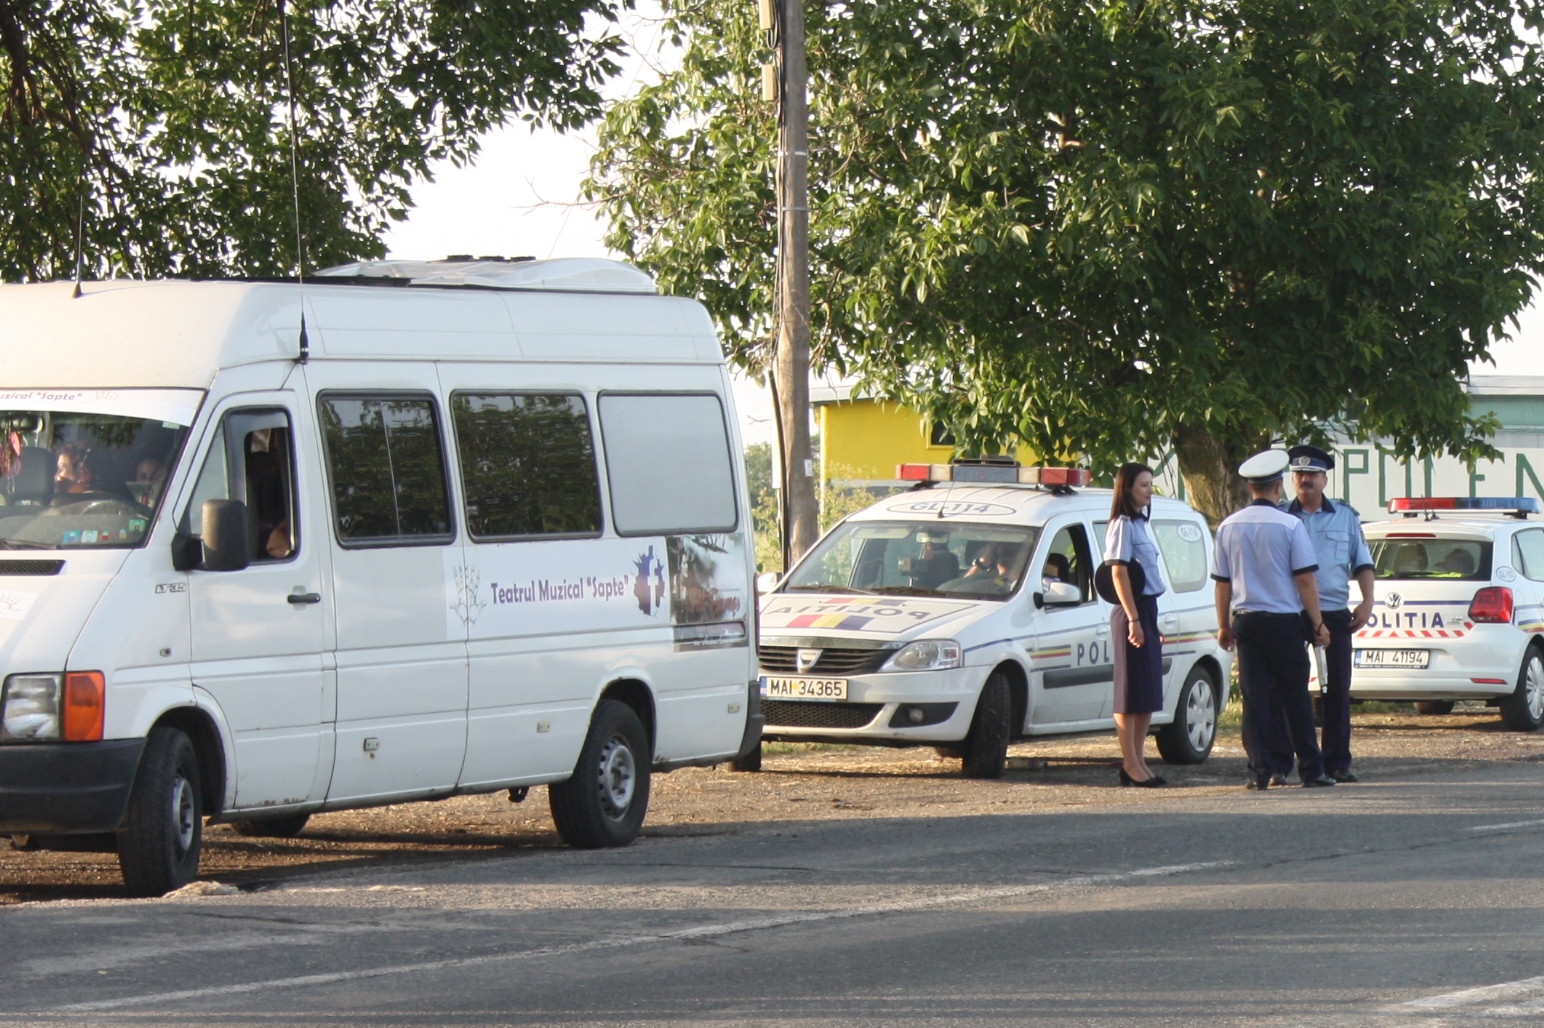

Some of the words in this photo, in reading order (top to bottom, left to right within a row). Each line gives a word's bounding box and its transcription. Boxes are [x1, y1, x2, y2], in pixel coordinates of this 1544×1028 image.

[910, 503, 990, 512] GL-114
[491, 580, 536, 604] Teatrul
[538, 577, 584, 601] Muzical
[1366, 612, 1444, 628] OLITIA
[1365, 650, 1384, 663] MAI
[1392, 651, 1423, 663] 41194
[770, 679, 793, 694] MAI
[798, 680, 842, 696] 34365
